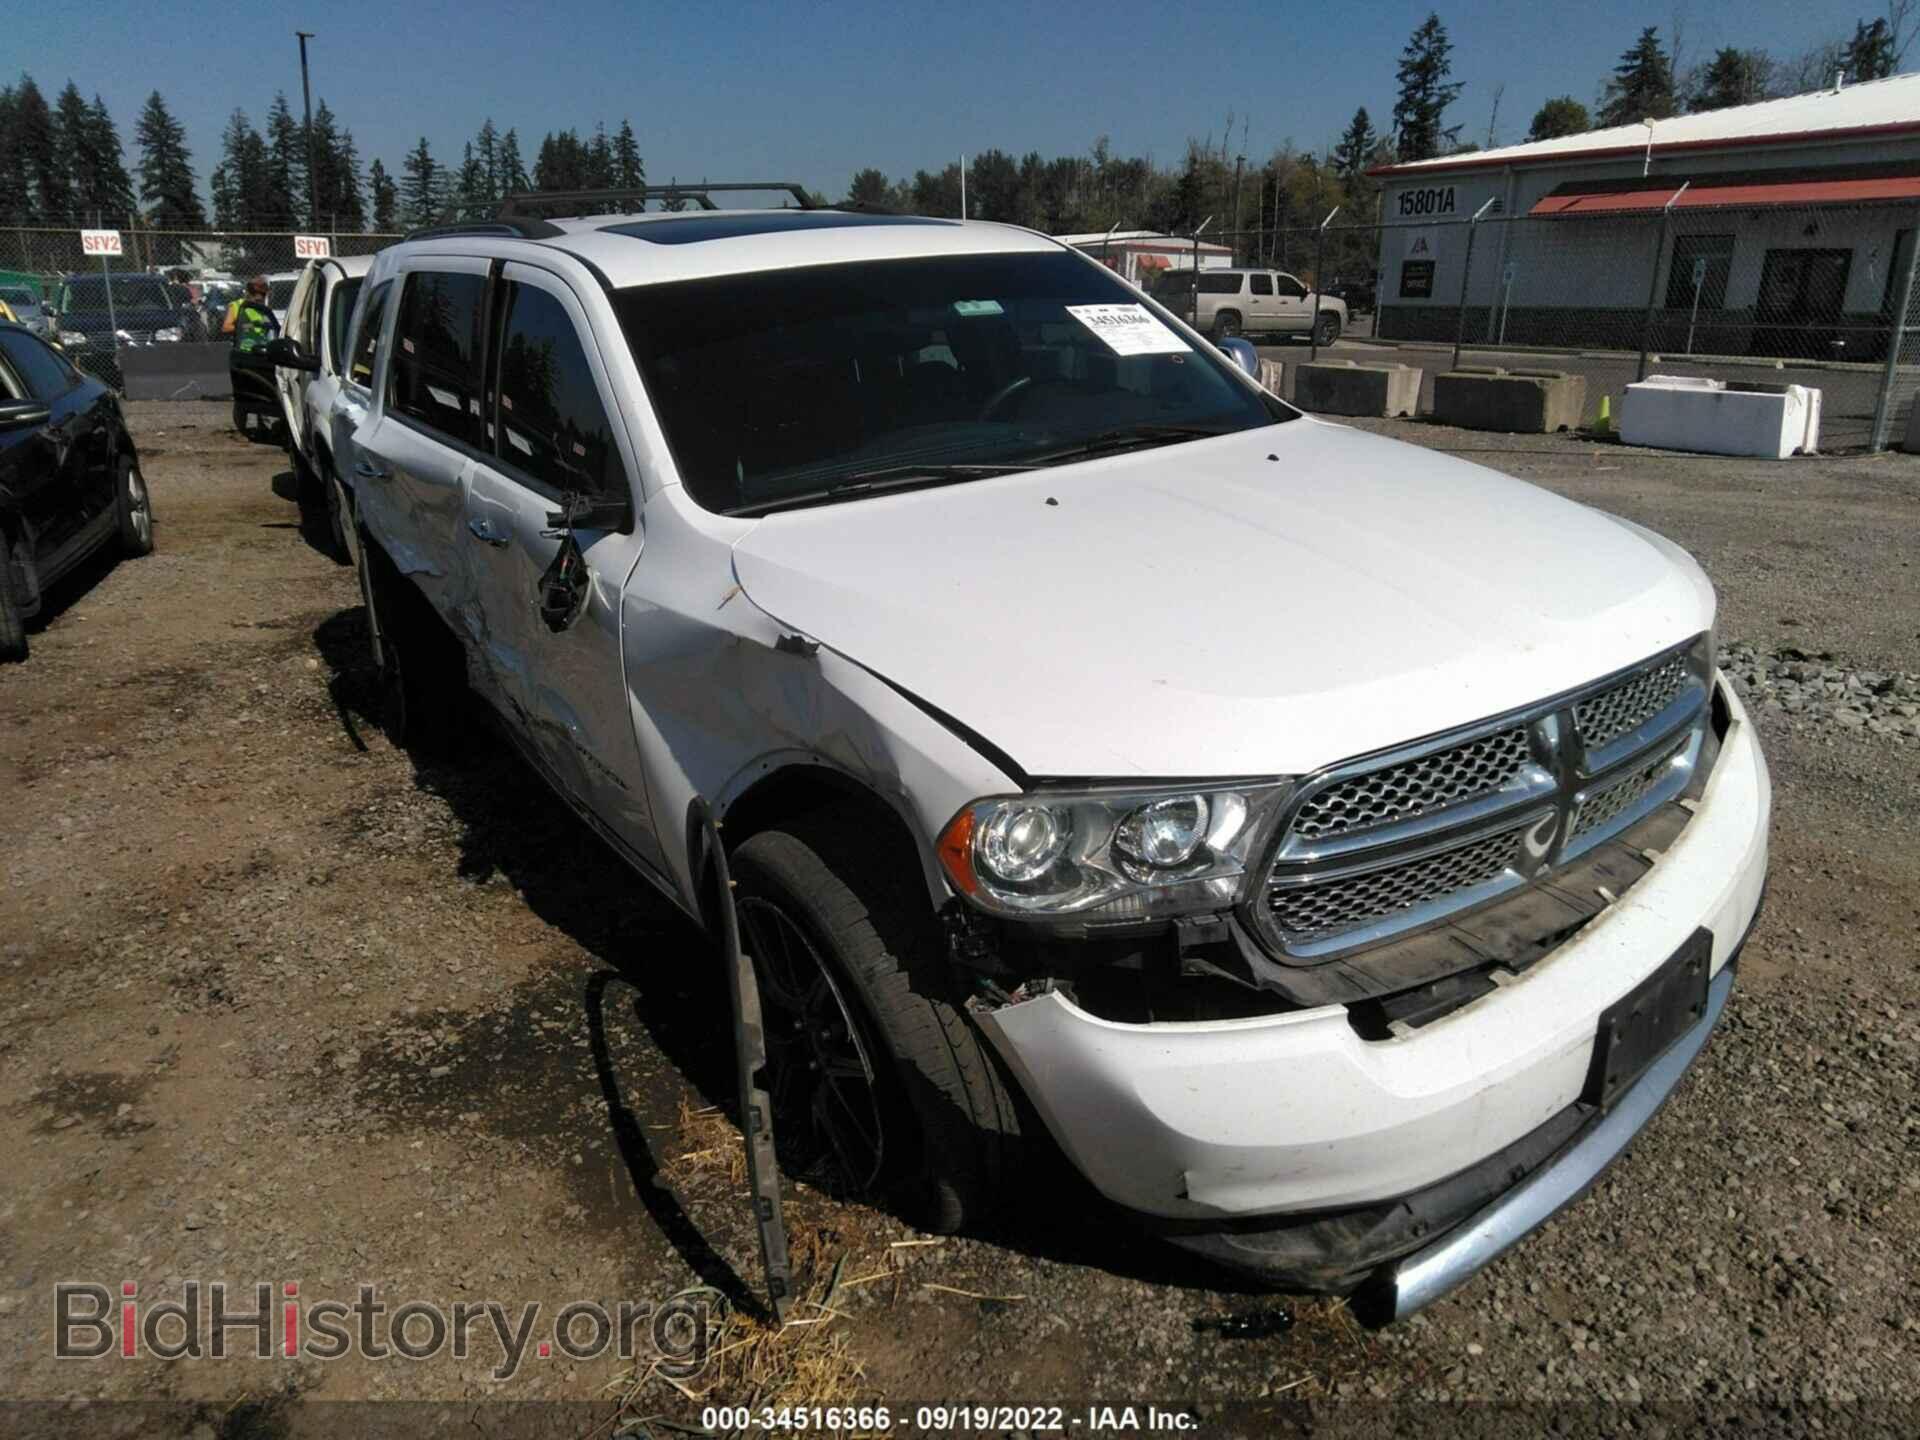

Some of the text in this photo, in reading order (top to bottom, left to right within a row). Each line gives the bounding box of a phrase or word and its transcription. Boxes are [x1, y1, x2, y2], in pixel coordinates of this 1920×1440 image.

[1398, 187, 1455, 215] 15801A
[83, 236, 120, 251] SFV2
[296, 239, 329, 255] SFV1
